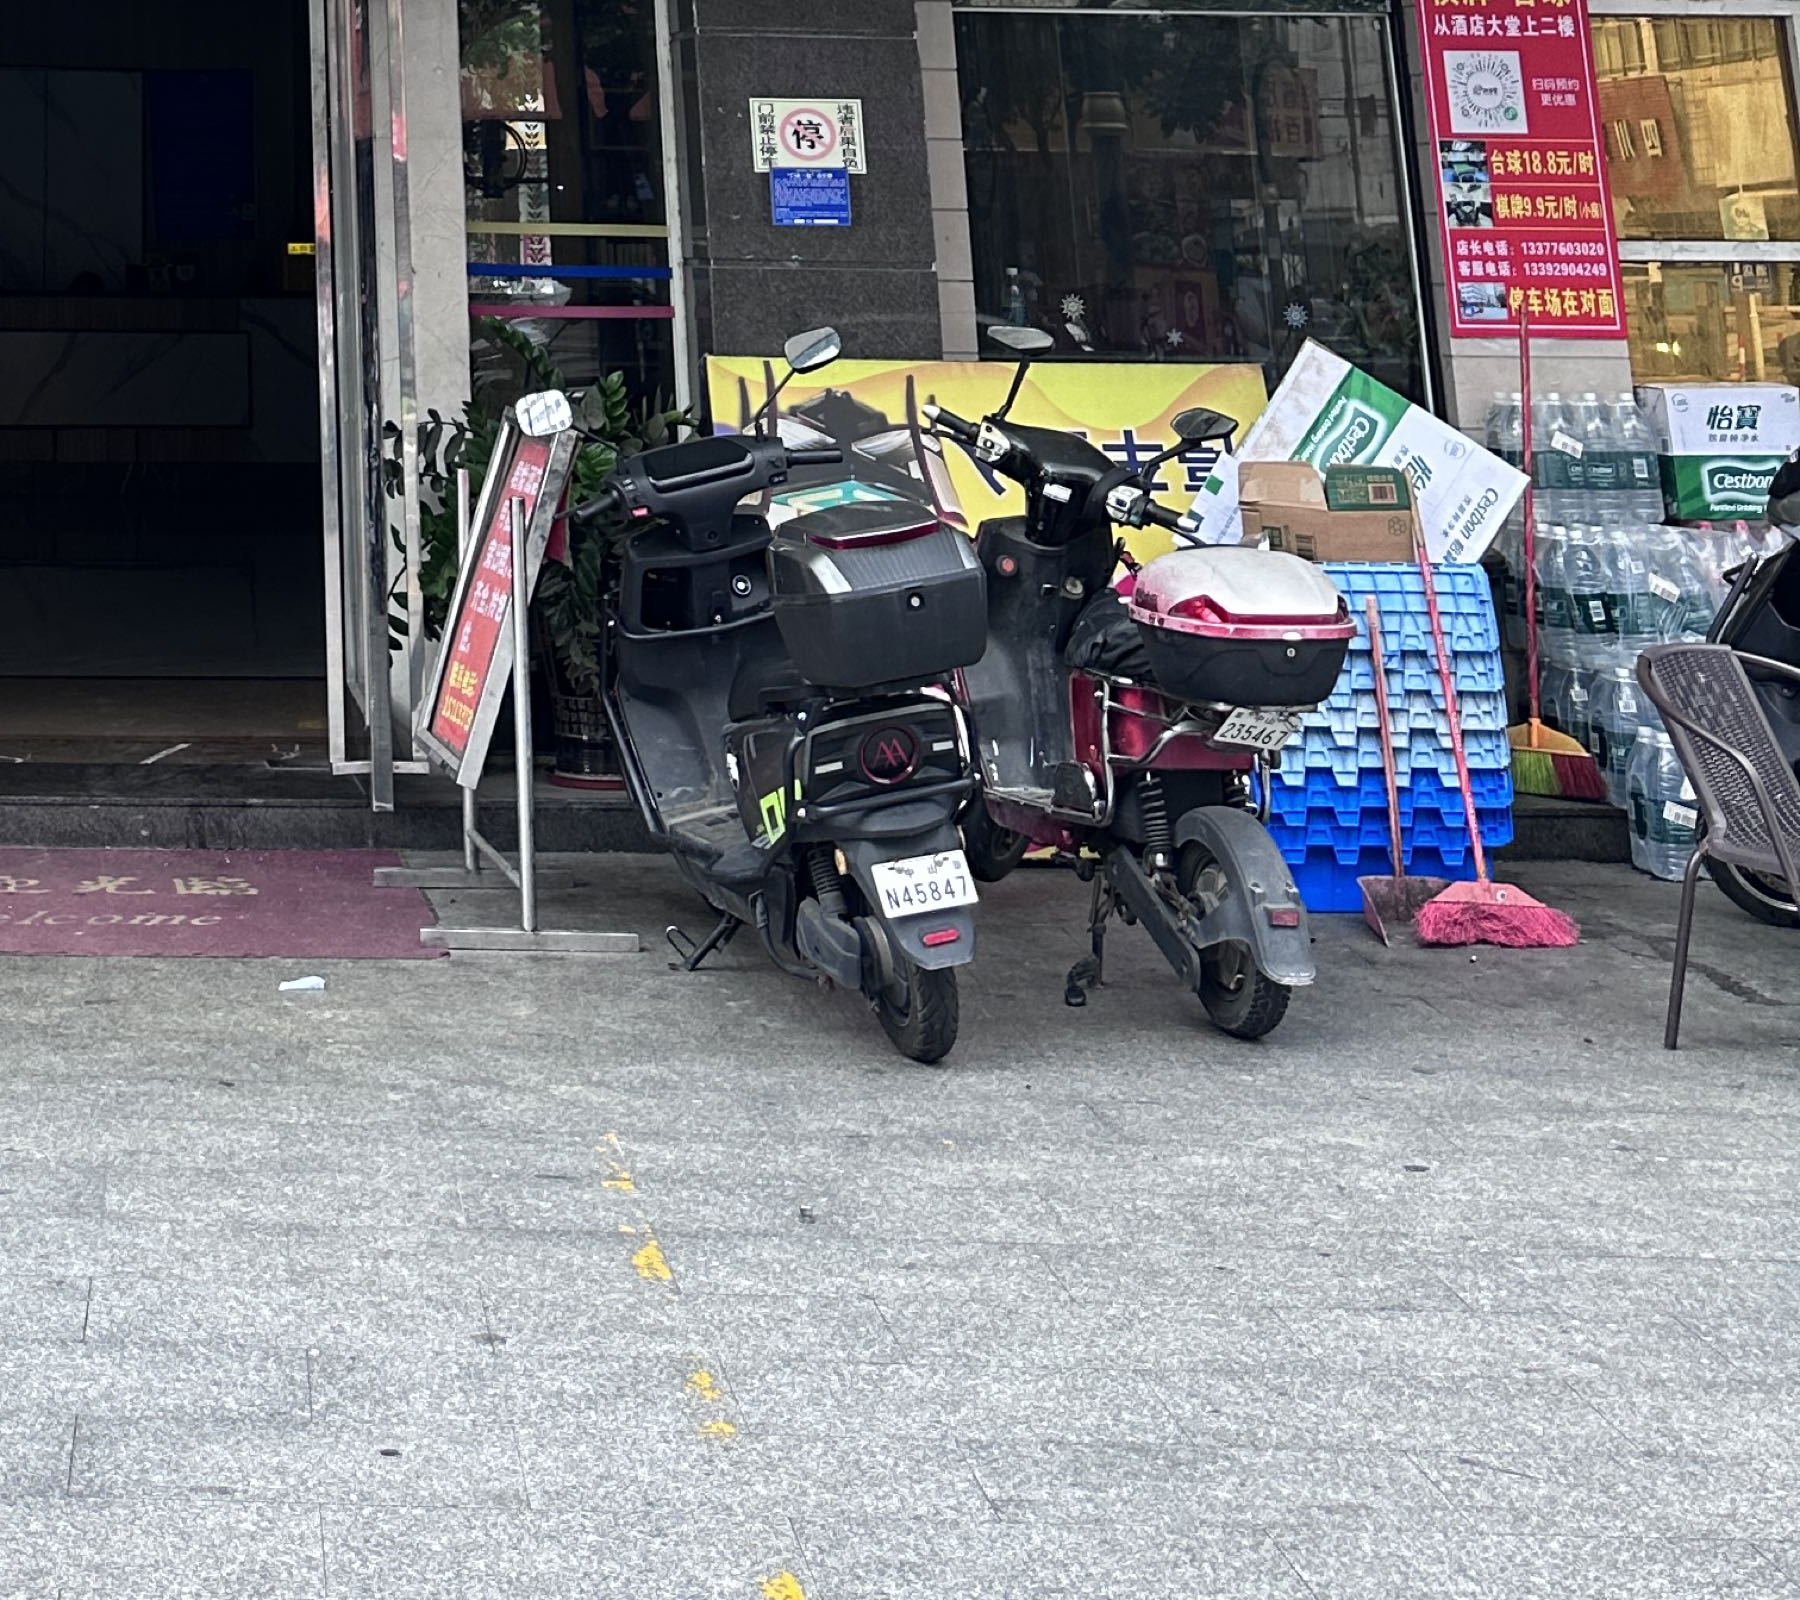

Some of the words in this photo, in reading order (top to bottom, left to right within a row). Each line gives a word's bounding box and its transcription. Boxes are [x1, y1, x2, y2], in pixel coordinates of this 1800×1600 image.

[1434, 13, 1576, 38] 从酒店大堂上二楼
[1532, 78, 1580, 92] 扫码预约
[792, 119, 824, 150] 停
[1490, 149, 1595, 176] 台球18.8元/时
[1509, 286, 1616, 318] 停车场在对面
[1706, 405, 1762, 430] 怡寶
[1460, 487, 1499, 540] Cestbon
[1219, 721, 1289, 746] 235467
[885, 875, 967, 910] N45847
